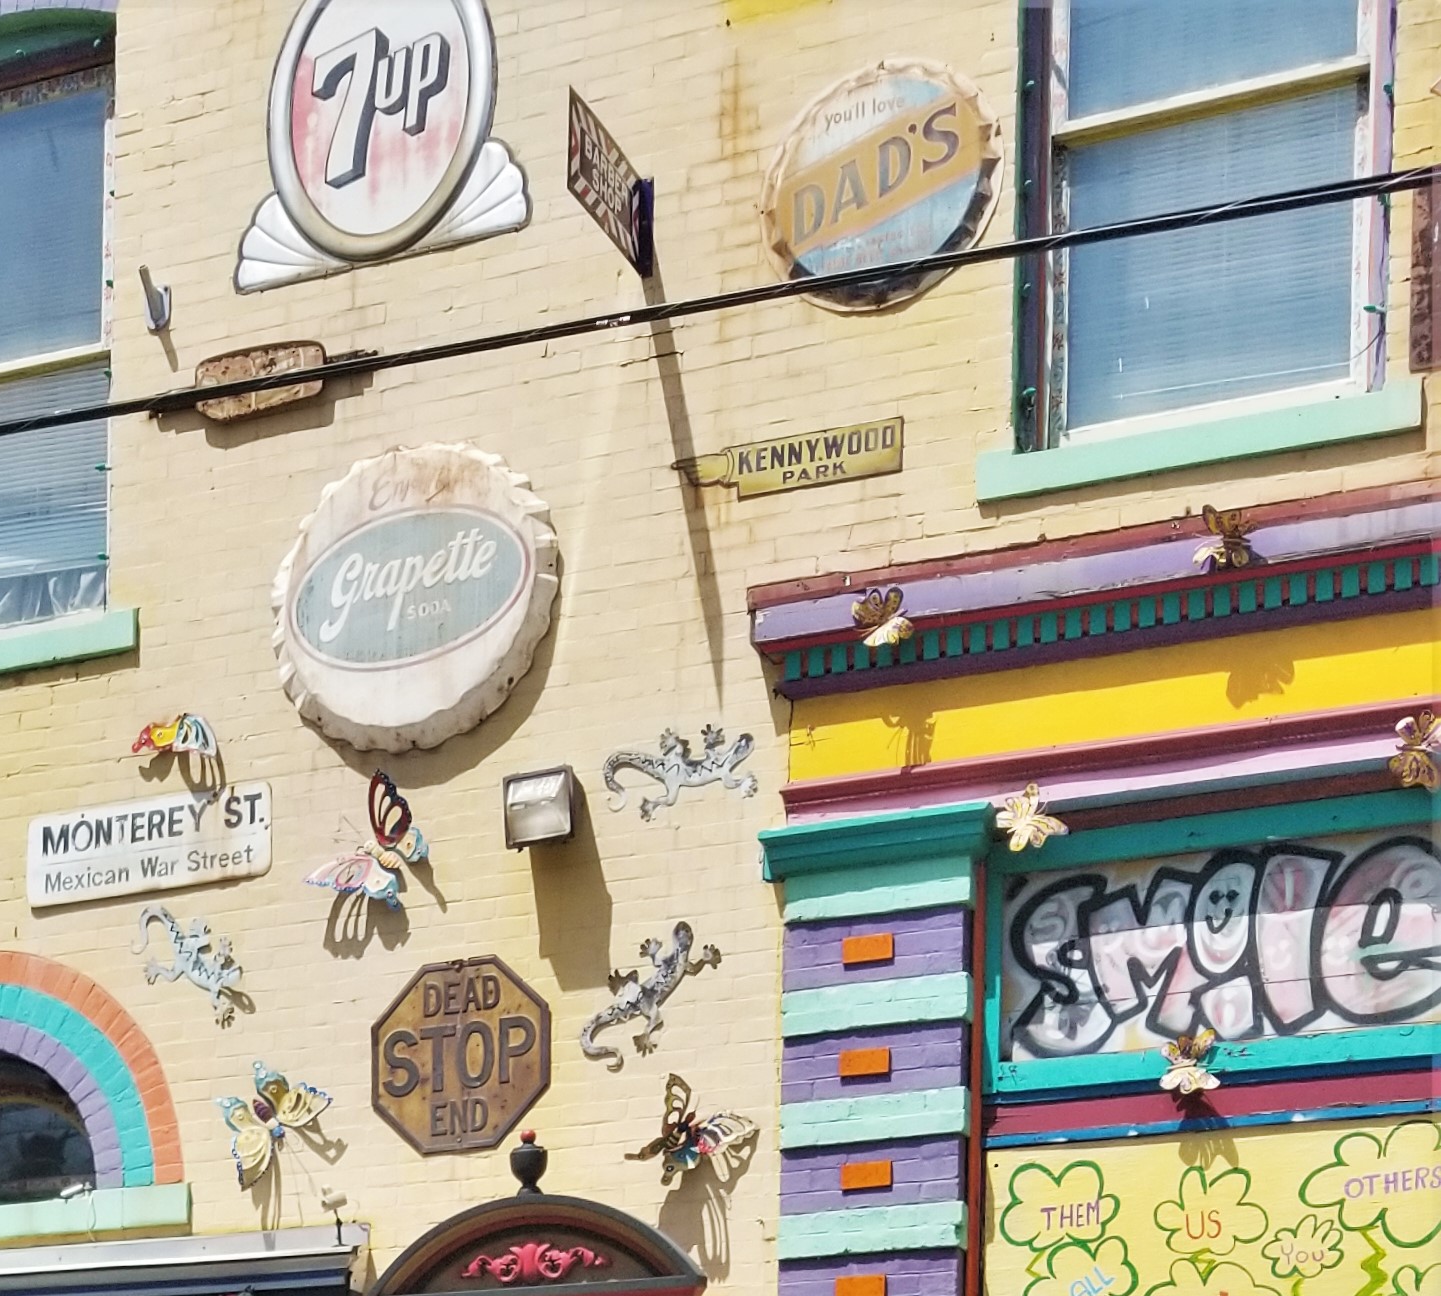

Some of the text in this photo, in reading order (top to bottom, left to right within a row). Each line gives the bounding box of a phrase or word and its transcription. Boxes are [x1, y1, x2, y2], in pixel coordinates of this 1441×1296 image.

[825, 97, 906, 132] you'll love
[584, 133, 629, 203] BARBER
[793, 101, 960, 247] DAD'S
[592, 168, 622, 216] SHOP
[782, 461, 847, 485] PARK
[319, 528, 497, 643] Grapette
[407, 601, 452, 620] SODA
[42, 793, 265, 857] MONTEREY ST.
[45, 844, 254, 894] Mexican War Street
[423, 974, 501, 1018] DEAD
[381, 1015, 537, 1098] STOP
[430, 1098, 490, 1137] END
[1343, 1167, 1441, 1200] OTHERS
[1040, 1202, 1102, 1231] THEM
[1184, 1209, 1222, 1240] US
